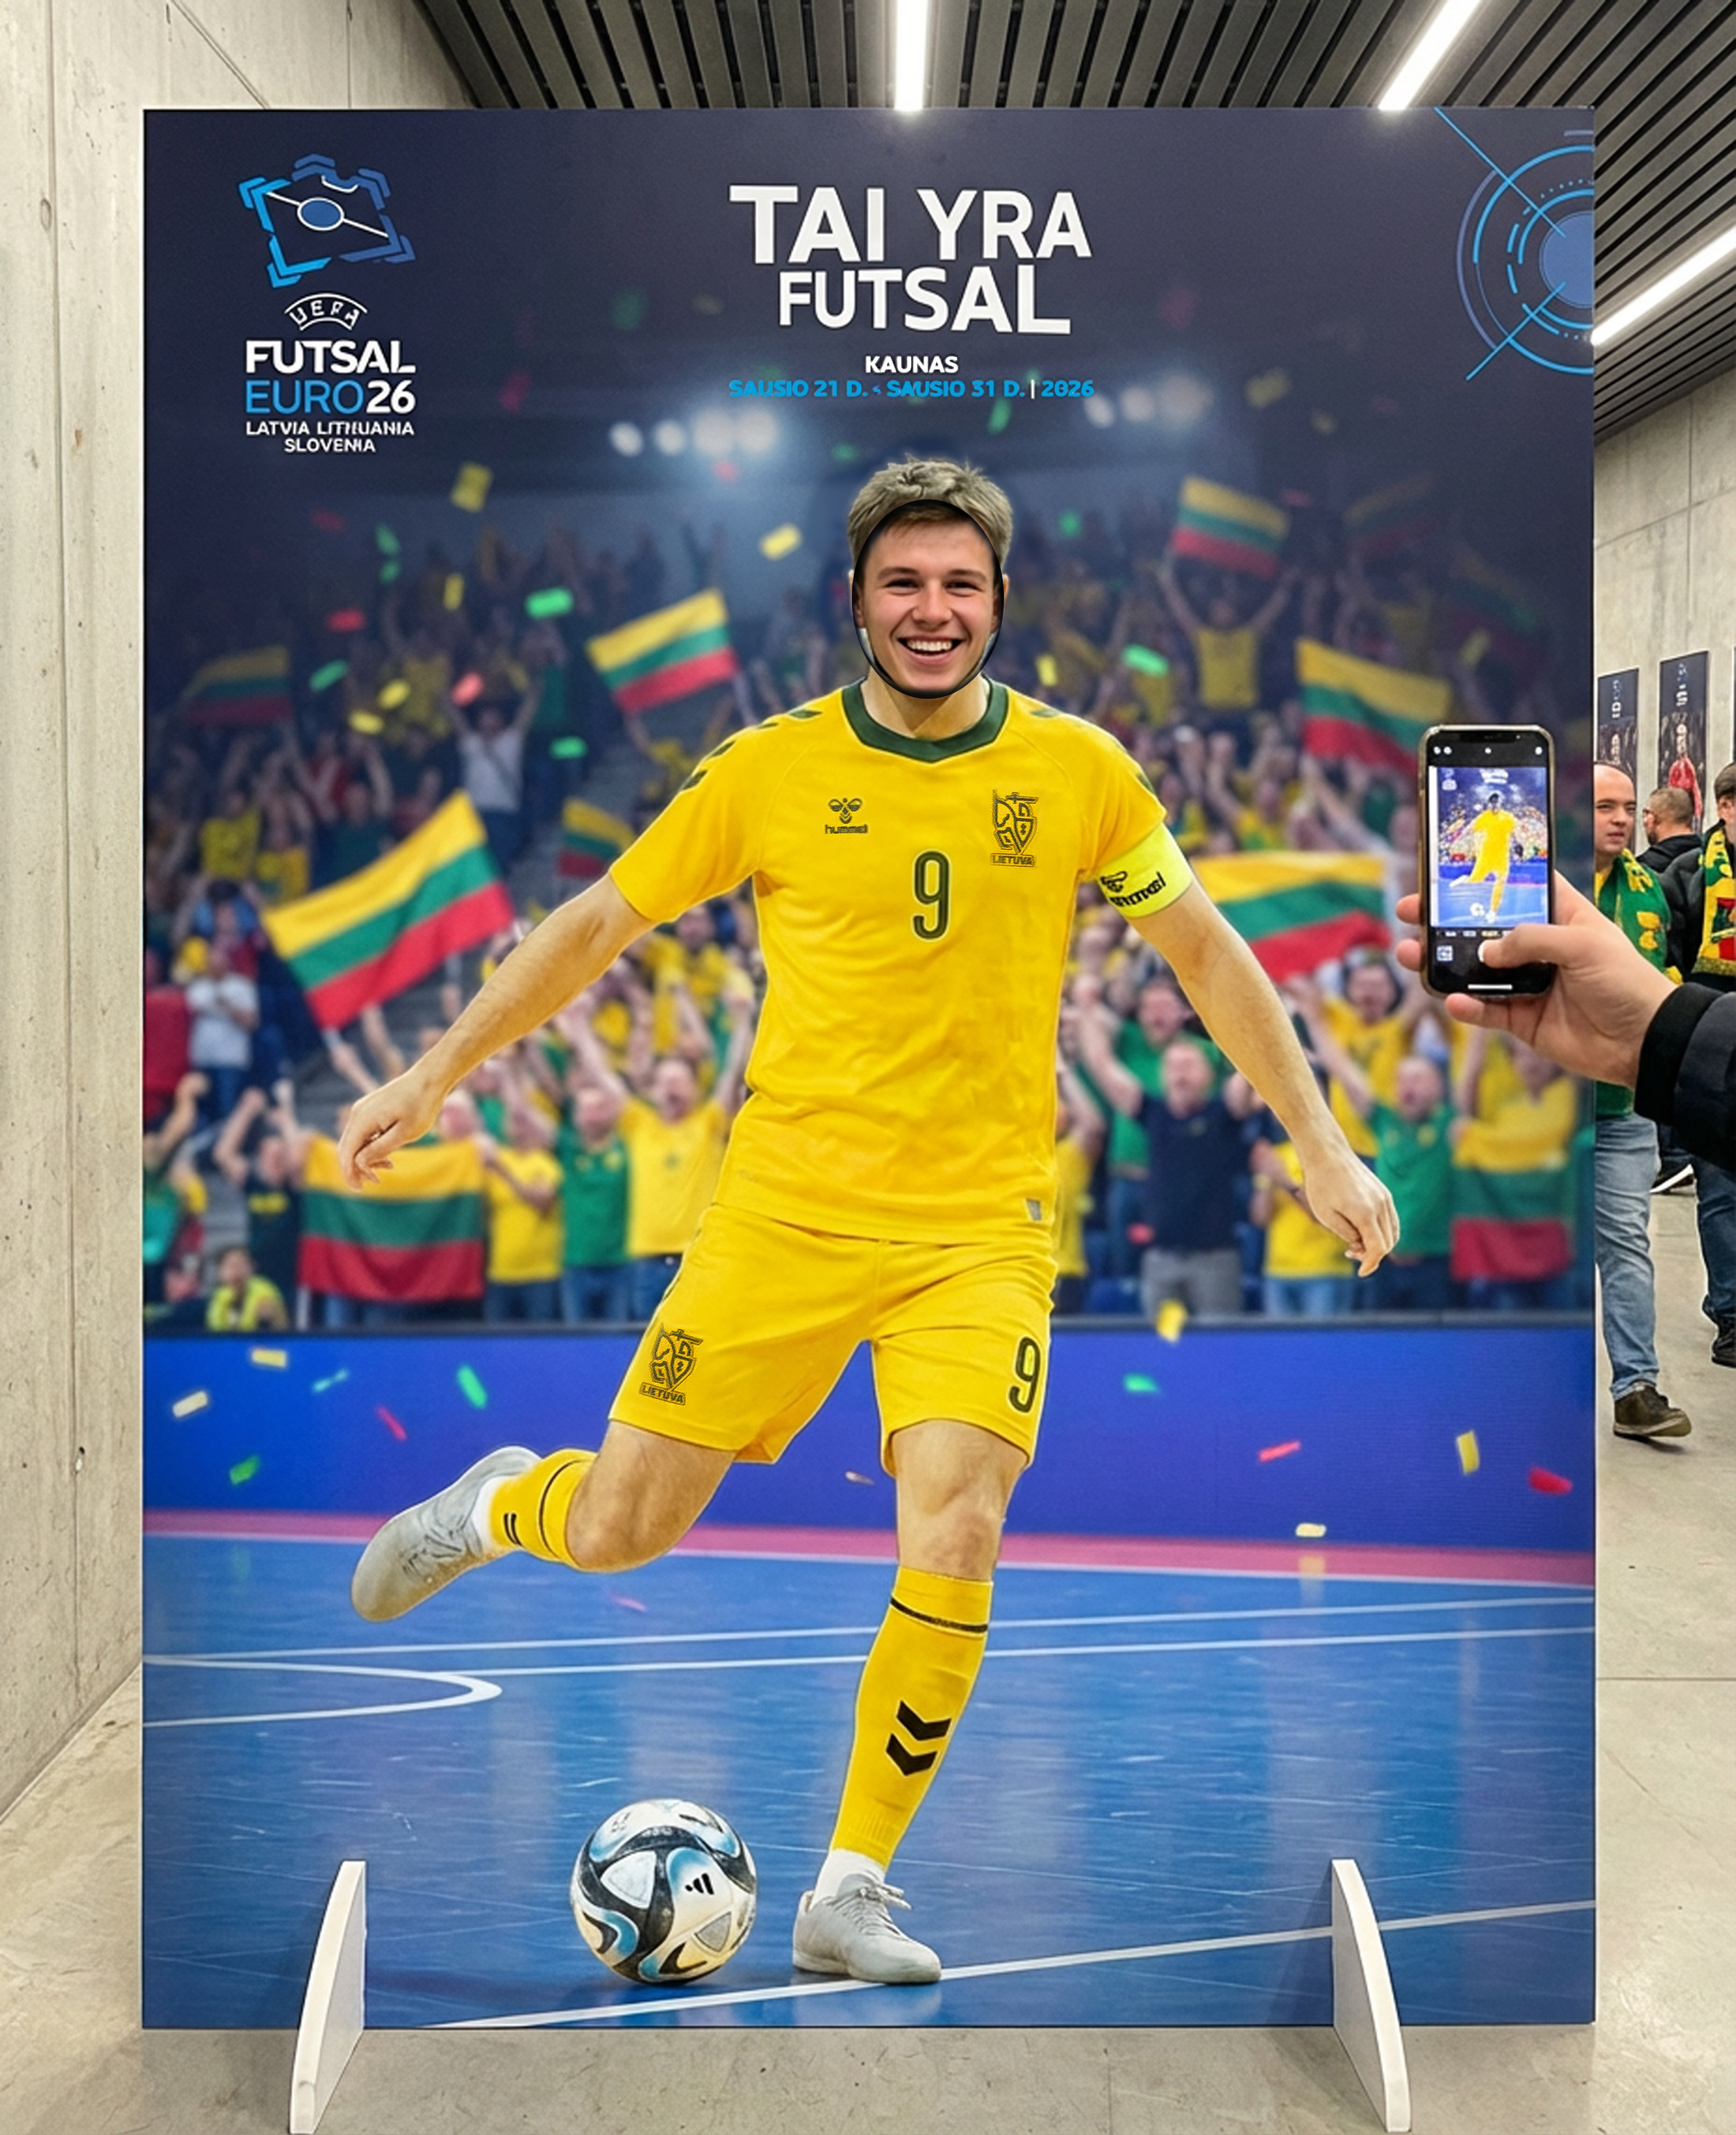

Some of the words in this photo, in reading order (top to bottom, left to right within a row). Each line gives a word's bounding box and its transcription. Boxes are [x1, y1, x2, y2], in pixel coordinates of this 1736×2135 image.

[729, 185, 884, 264] TAI
[917, 189, 1092, 260] YRA
[779, 265, 1071, 335] FUTSAL
[246, 340, 416, 374] FUTSAL
[865, 355, 958, 373] KAUNAS
[730, 380, 809, 397] SAUSIO
[815, 380, 837, 397] 21
[847, 380, 867, 397] D.
[887, 380, 965, 397] SAUSIO
[971, 380, 994, 397] 31
[1004, 380, 1025, 397] D.
[1042, 380, 1094, 397] 2026
[247, 421, 310, 435] LATVIA
[284, 438, 376, 452] SLOVENIA
[913, 851, 950, 939] 9
[1009, 1337, 1041, 1413] 9
[641, 1384, 684, 1403] LIETUVA
